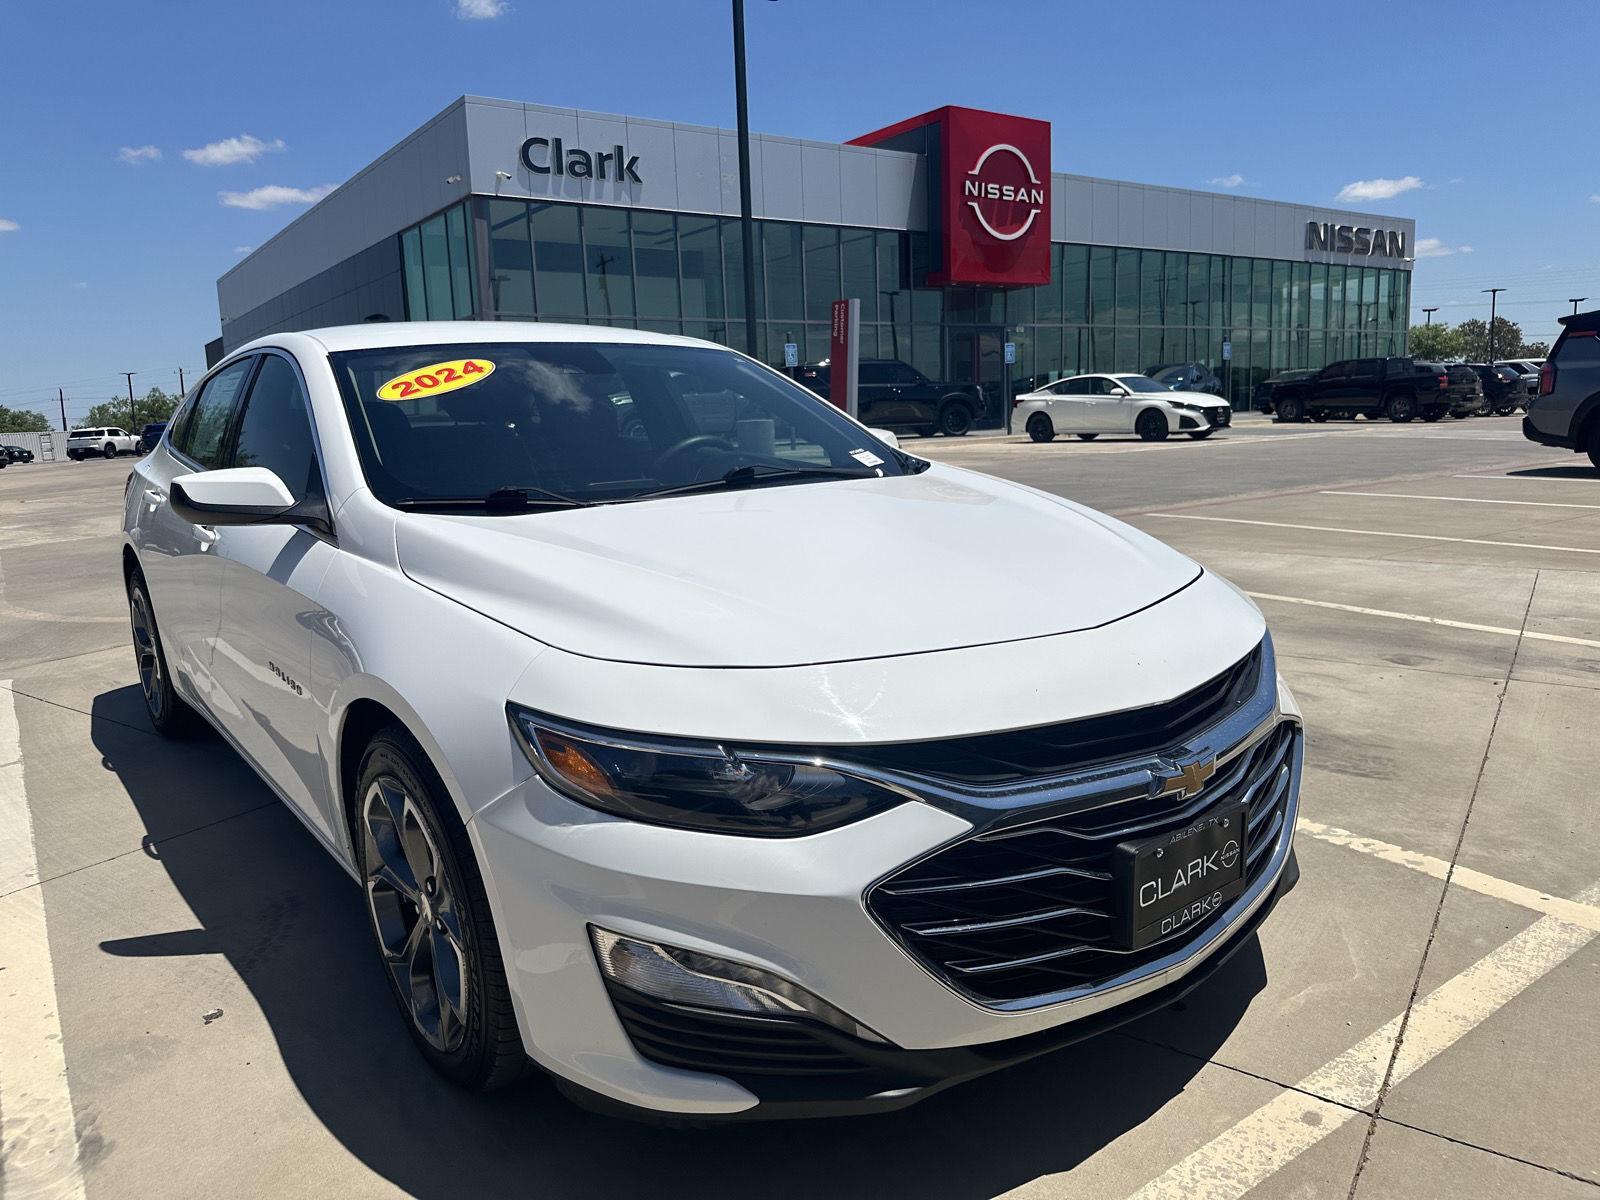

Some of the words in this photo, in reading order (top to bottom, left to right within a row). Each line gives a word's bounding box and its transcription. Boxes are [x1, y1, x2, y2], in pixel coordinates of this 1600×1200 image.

[519, 137, 642, 184] Clark
[965, 180, 1044, 204] NISSAN
[1305, 221, 1406, 258] NISSAN
[391, 361, 485, 398] 2024
[1208, 816, 1220, 827] TX
[1140, 850, 1219, 908] CLARK
[1161, 896, 1212, 935] CLARK
